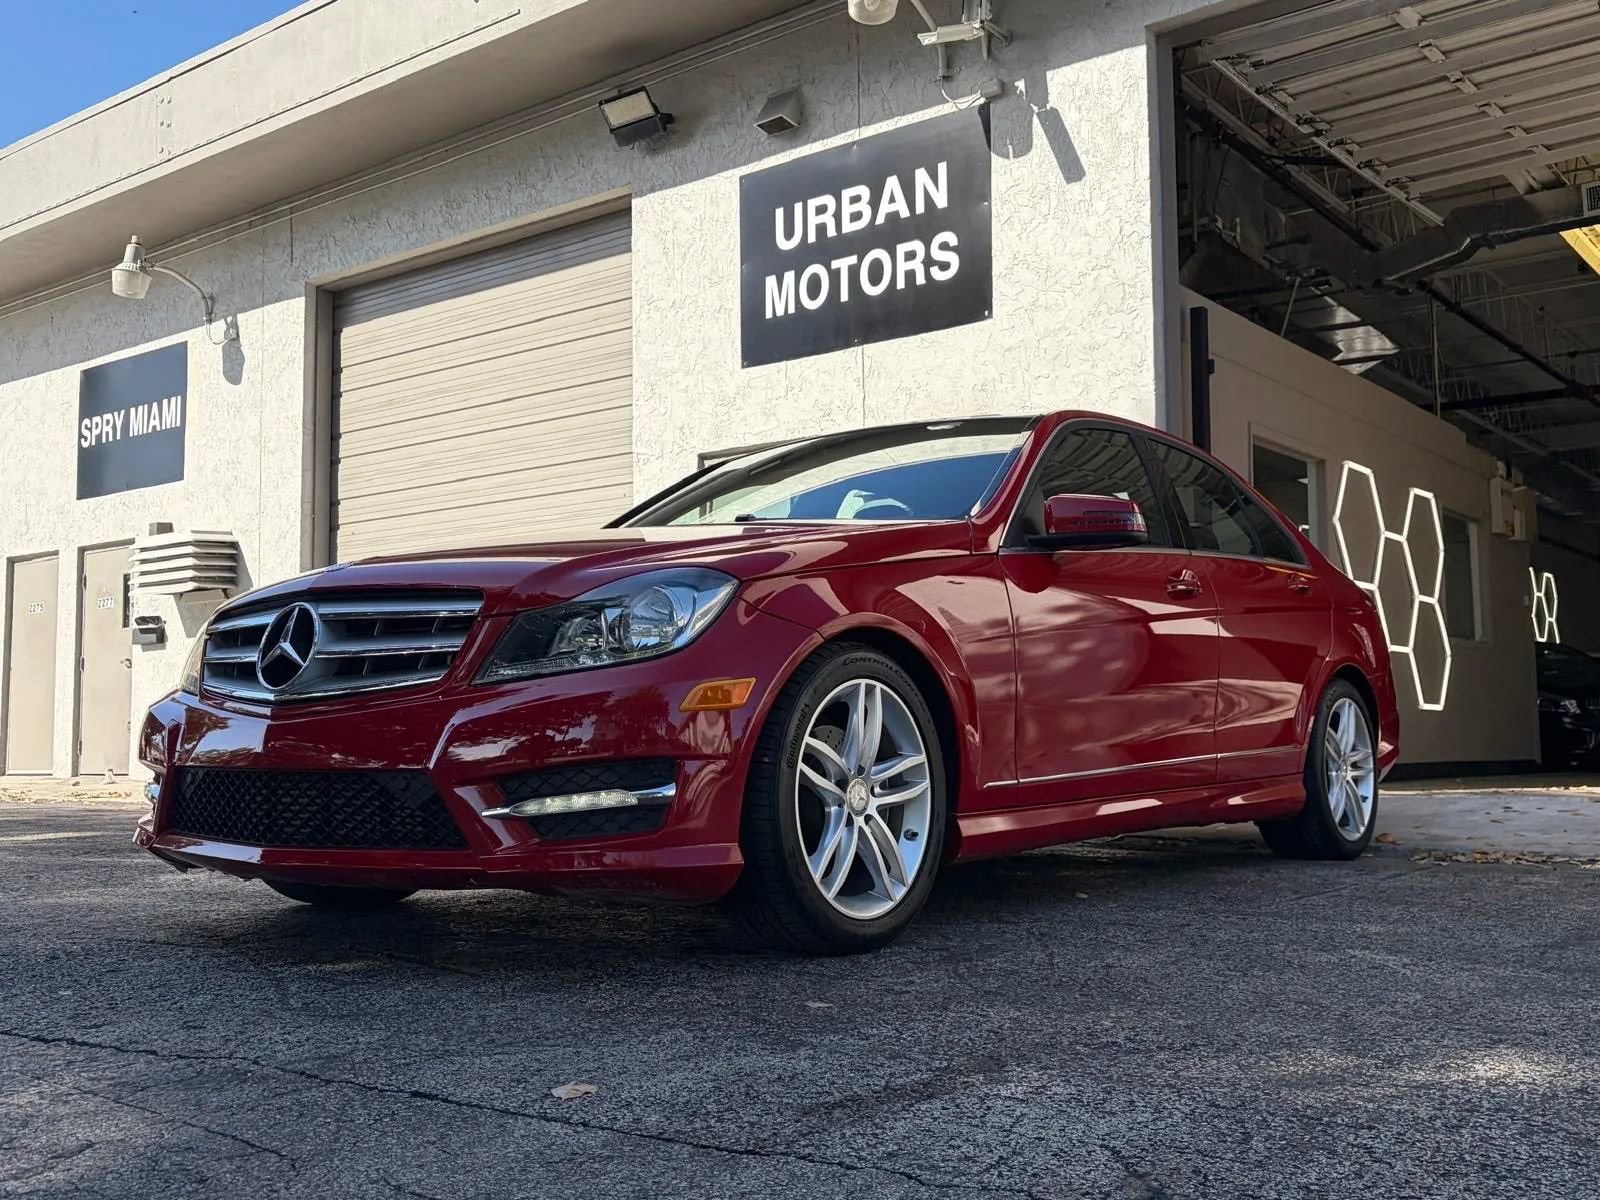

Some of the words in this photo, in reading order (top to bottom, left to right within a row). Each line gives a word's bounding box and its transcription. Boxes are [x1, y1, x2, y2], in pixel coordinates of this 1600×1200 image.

[775, 161, 948, 250] URBAN
[765, 231, 960, 319] MOTORS
[80, 409, 125, 448] SPRY
[129, 395, 182, 437] MIAMI
